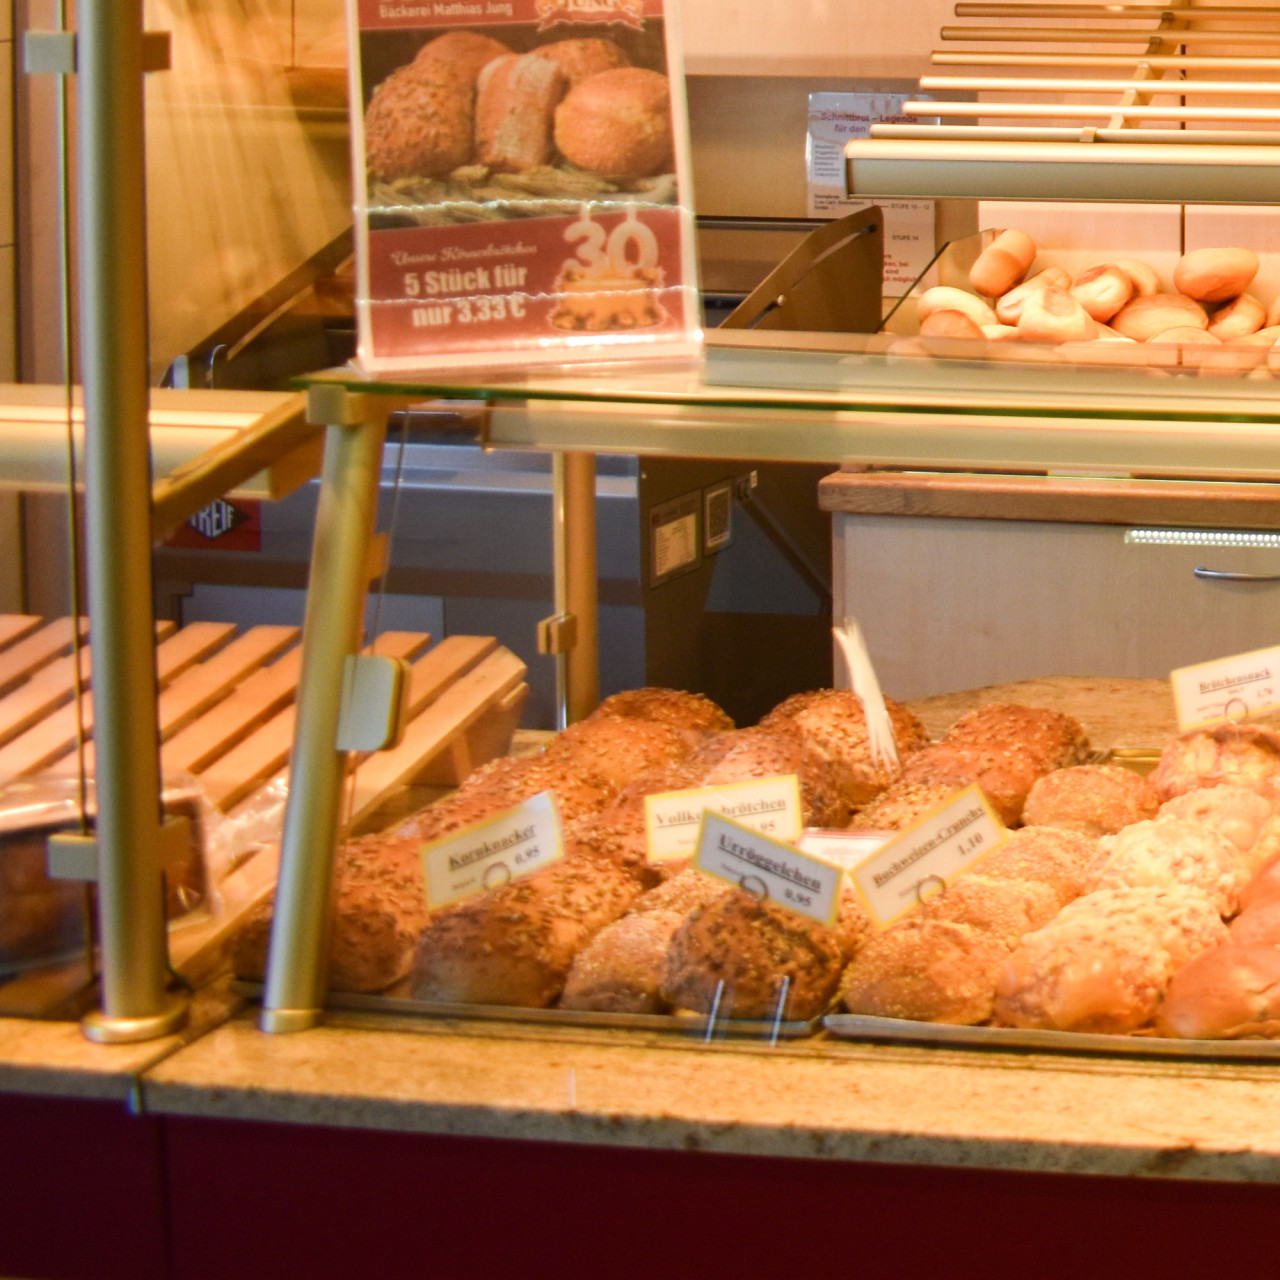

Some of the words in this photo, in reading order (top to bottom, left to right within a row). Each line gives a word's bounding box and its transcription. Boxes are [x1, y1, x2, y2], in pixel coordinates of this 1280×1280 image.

[379, 3, 431, 18] Bäckerei
[434, 2, 482, 17] Matthias
[486, 1, 513, 18] Jung
[834, 124, 847, 133] für
[849, 124, 866, 133] den
[404, 272, 421, 296] 5
[426, 266, 490, 295] Stück
[495, 264, 528, 288] für
[412, 305, 453, 327] nur
[719, 833, 822, 890] Urröggelchen
[785, 888, 812, 907] 0,95
